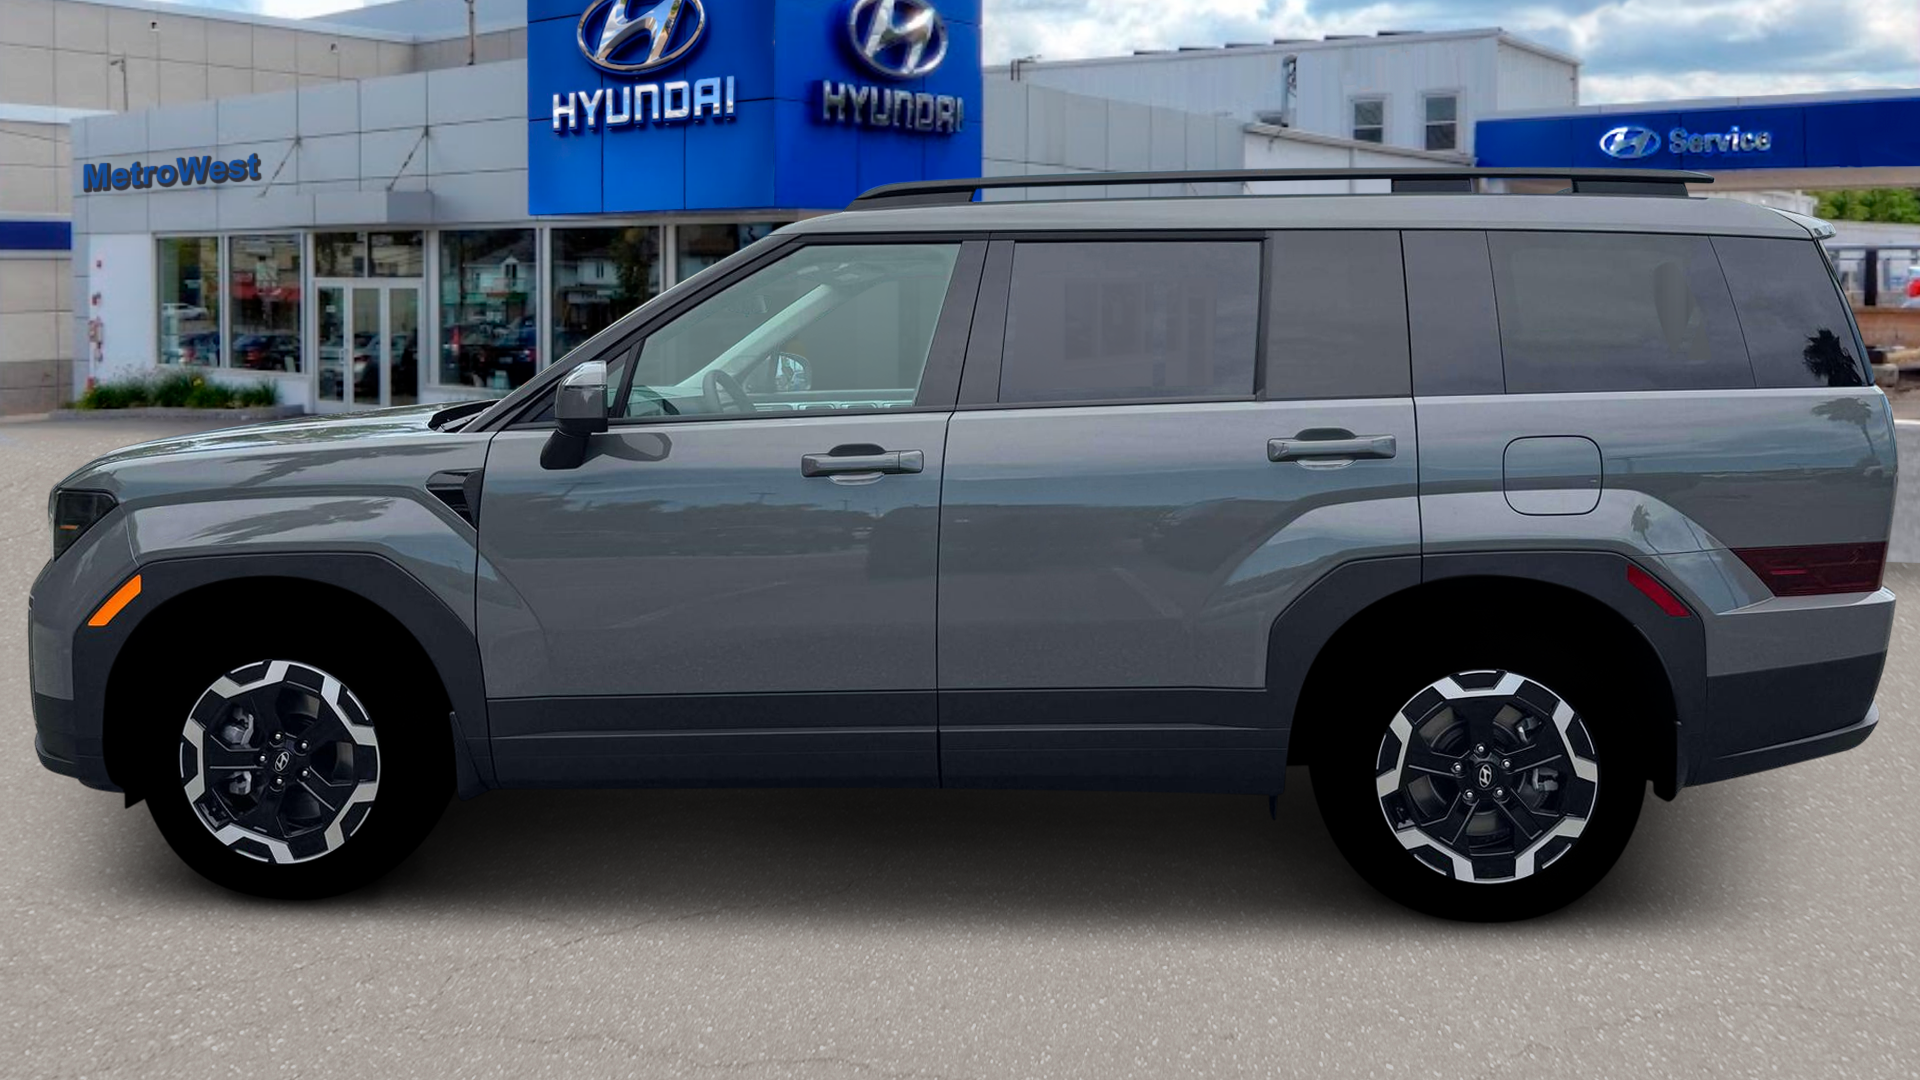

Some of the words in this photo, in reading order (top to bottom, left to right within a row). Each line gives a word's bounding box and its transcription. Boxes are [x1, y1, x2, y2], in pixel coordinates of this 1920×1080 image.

[552, 76, 735, 131] HYUNDAI
[822, 79, 965, 134] HYUNDAI
[1668, 125, 1772, 154] Service
[83, 153, 262, 193] MetroWest
